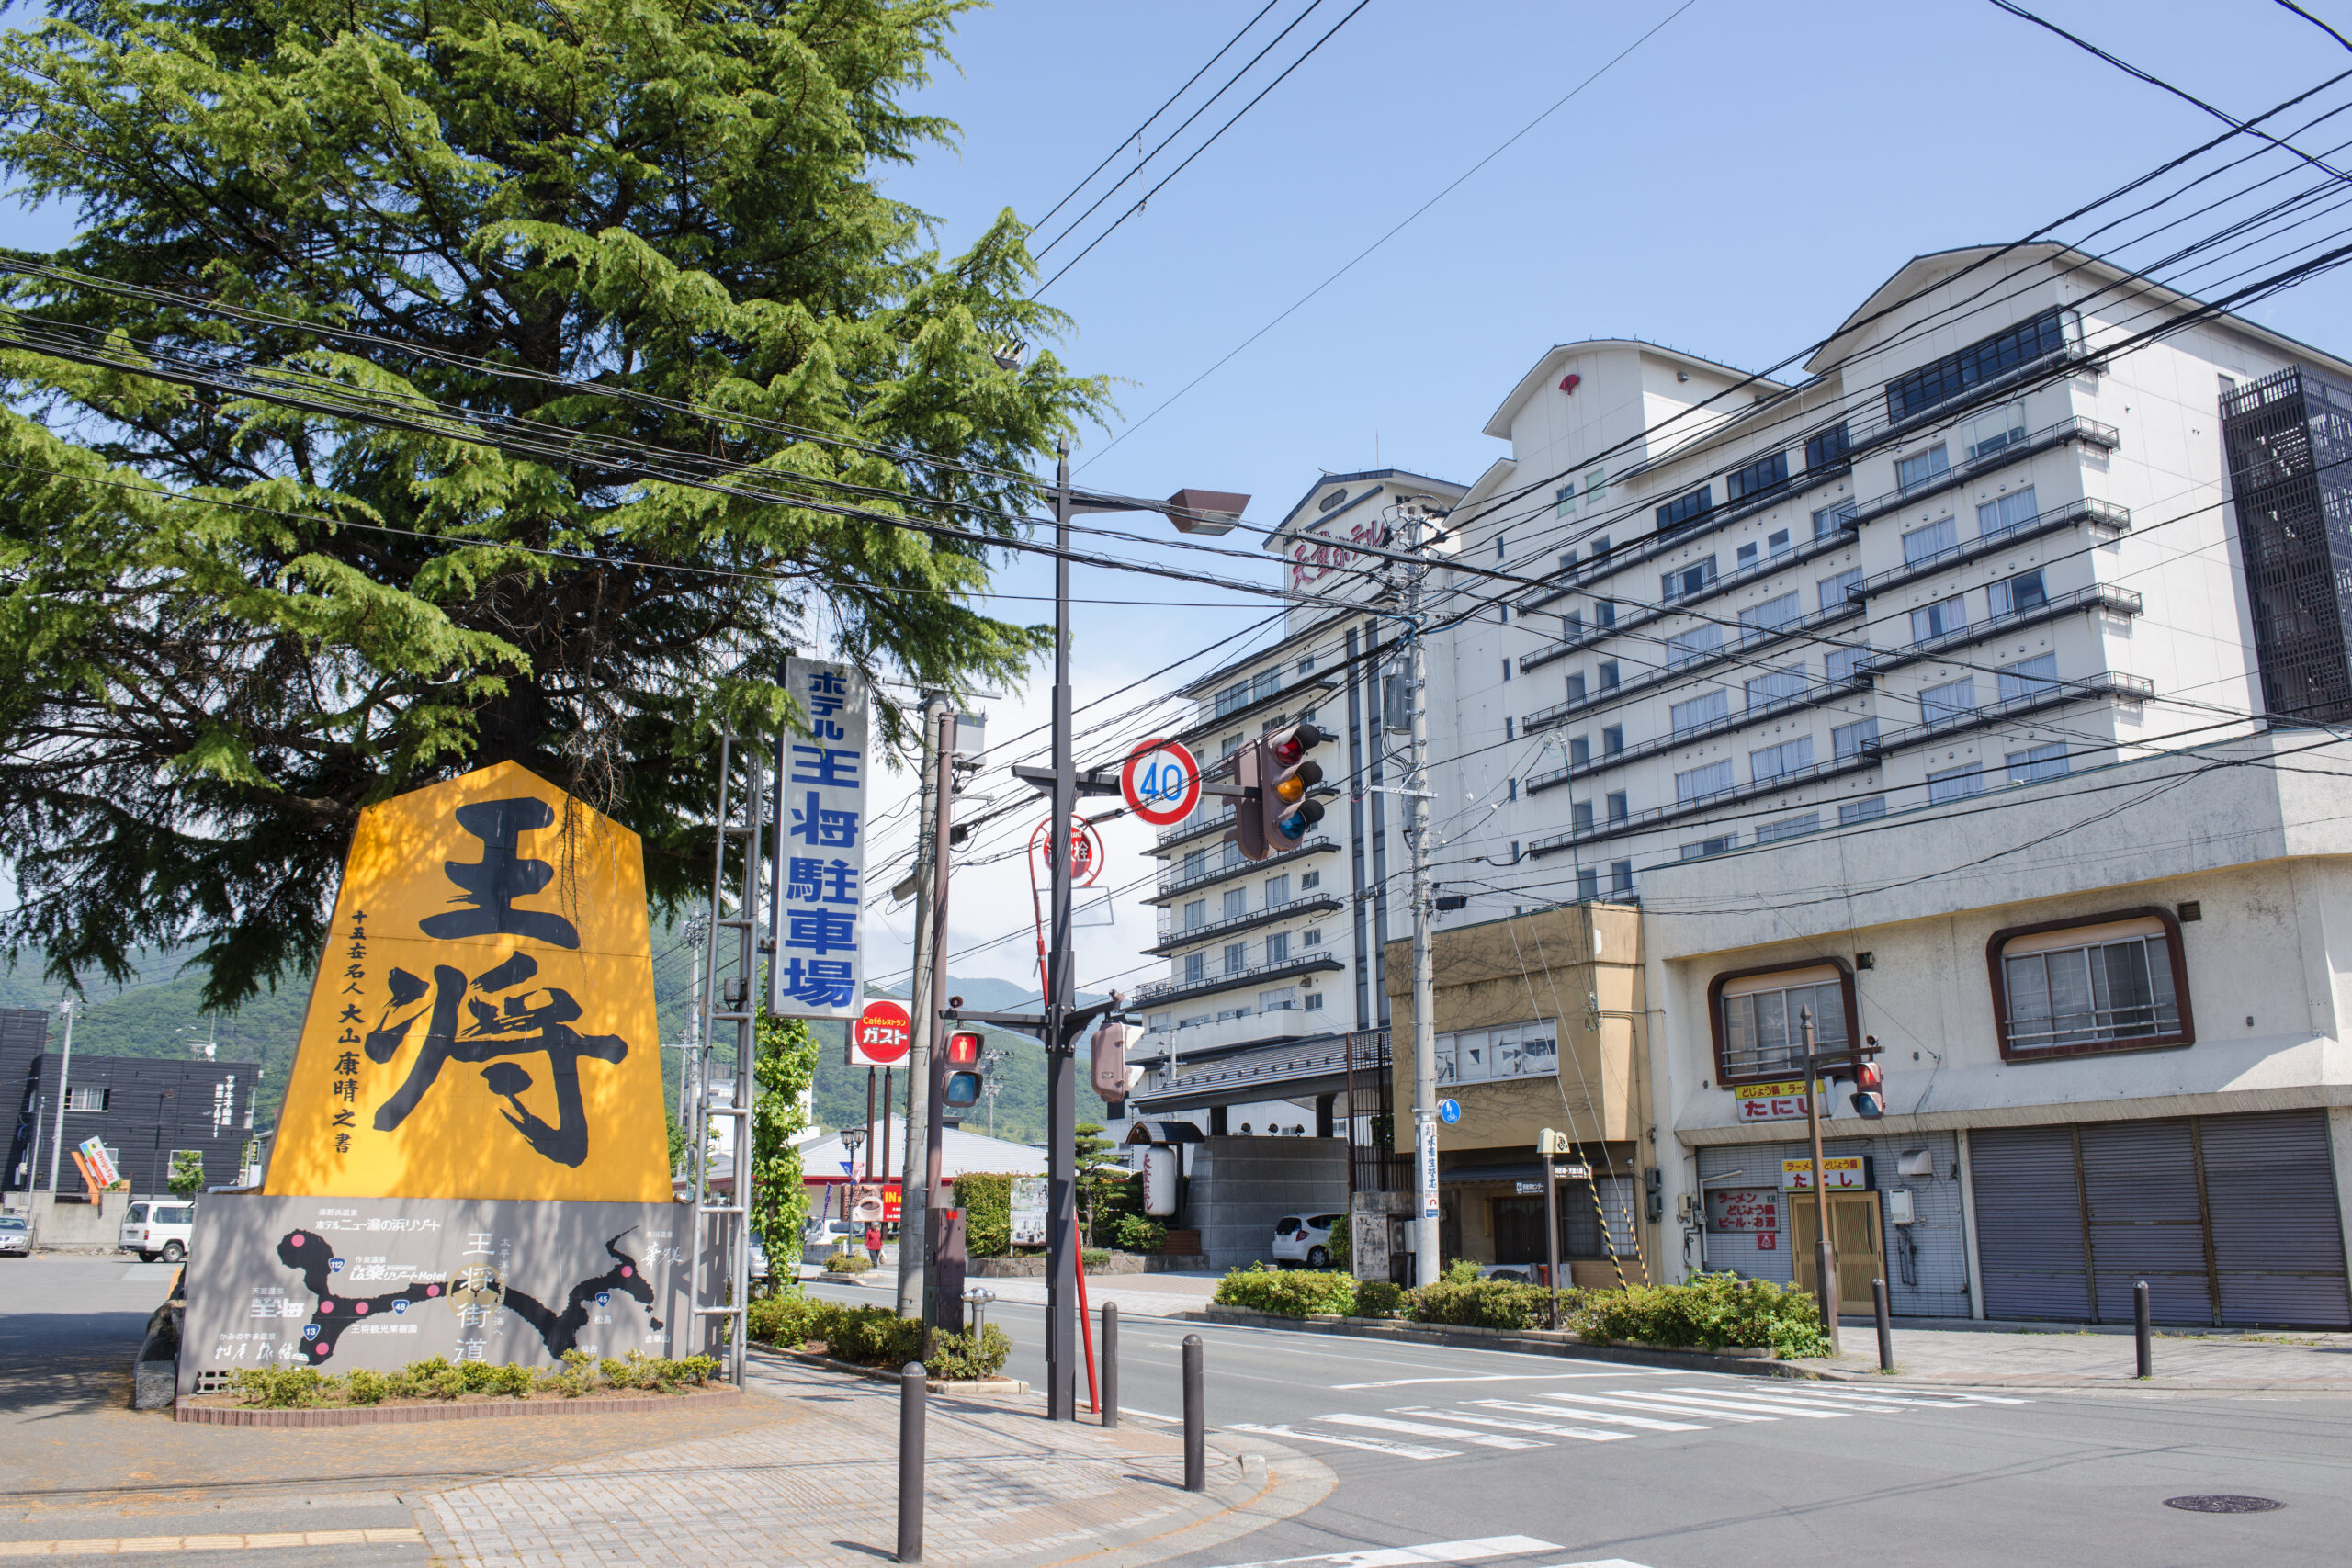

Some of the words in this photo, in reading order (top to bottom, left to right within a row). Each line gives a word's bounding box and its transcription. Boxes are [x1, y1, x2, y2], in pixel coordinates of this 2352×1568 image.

[1140, 762, 1182, 802] 40
[783, 672, 861, 1008] ホテル王将駐車場
[364, 796, 628, 1168] 王将
[863, 1027, 908, 1045] ガスト
[1717, 1192, 1758, 1204] ラーメン
[331, 1261, 344, 1269] 112
[453, 1232, 496, 1364] 王将街道
[597, 1295, 608, 1303] 45
[395, 1303, 406, 1311] 48
[594, 1315, 612, 1325] 松島
[306, 1327, 316, 1336] 13
[581, 1344, 598, 1354] 仙台
